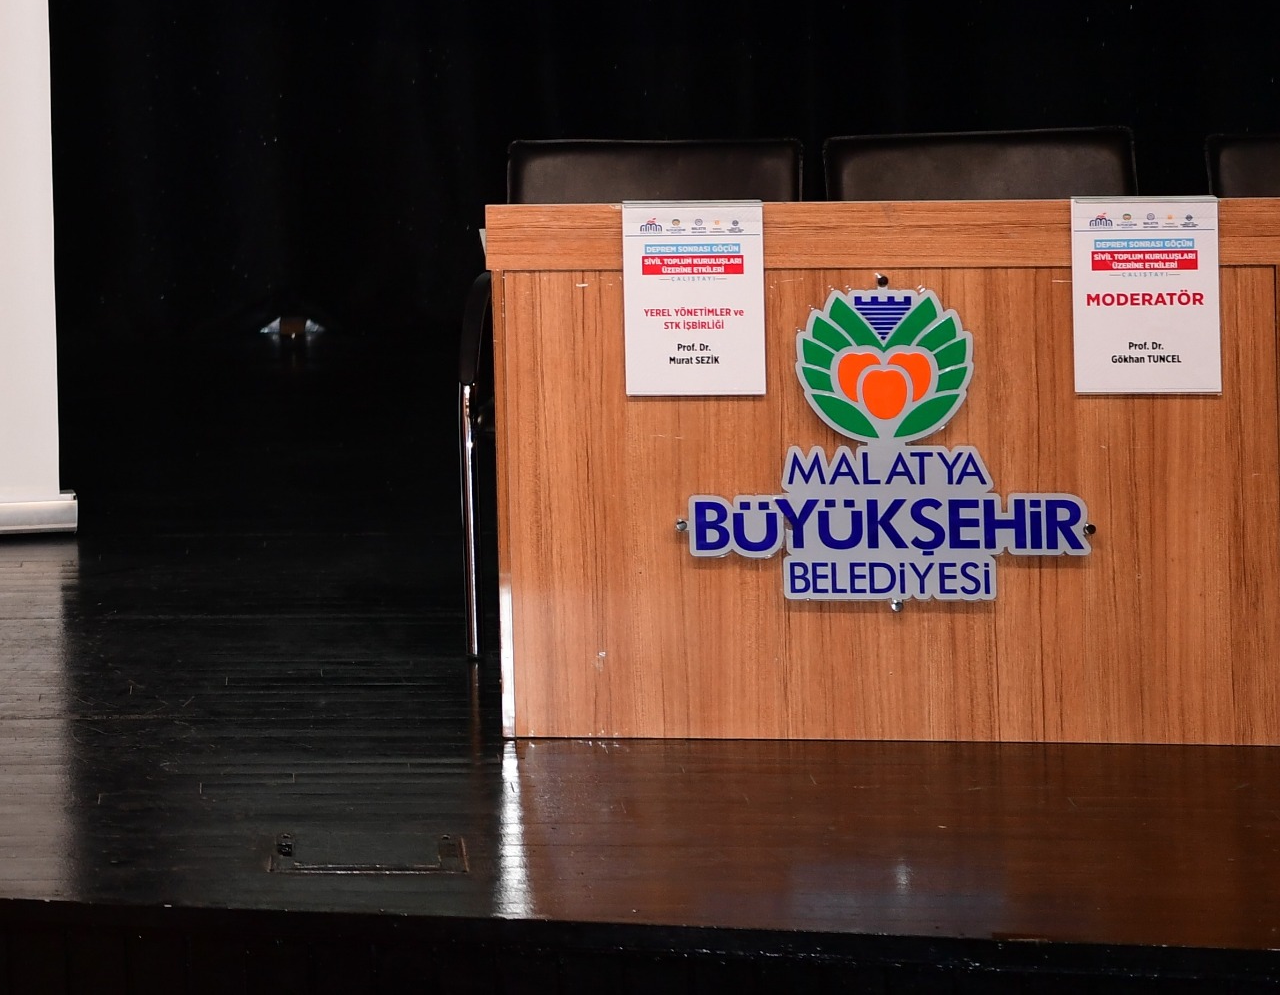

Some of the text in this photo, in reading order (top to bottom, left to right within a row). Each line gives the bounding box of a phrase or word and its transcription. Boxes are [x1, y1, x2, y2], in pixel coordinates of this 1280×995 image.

[646, 245, 676, 253] DEPREM
[678, 244, 710, 252] SONRASI
[1096, 240, 1127, 248] DEPREM
[1129, 240, 1163, 248] SONRASI
[644, 257, 662, 265] SİVİL
[1093, 253, 1112, 261] SİVİL
[1086, 289, 1204, 306] MODERATÖR
[644, 308, 672, 317] YEREL
[674, 307, 731, 317] YÖNETİMLER
[664, 321, 681, 330] STK
[677, 343, 711, 351] Prof. Dr.
[1128, 342, 1164, 350] Prof. Dr.
[669, 355, 720, 364] Murat SEZİK
[1111, 355, 1181, 363] Gökhan TUNCEL
[788, 451, 988, 486] MALATYA
[694, 498, 1085, 556] BÜYÜKŞEHİR
[790, 561, 991, 595] BELEDİYESİ
